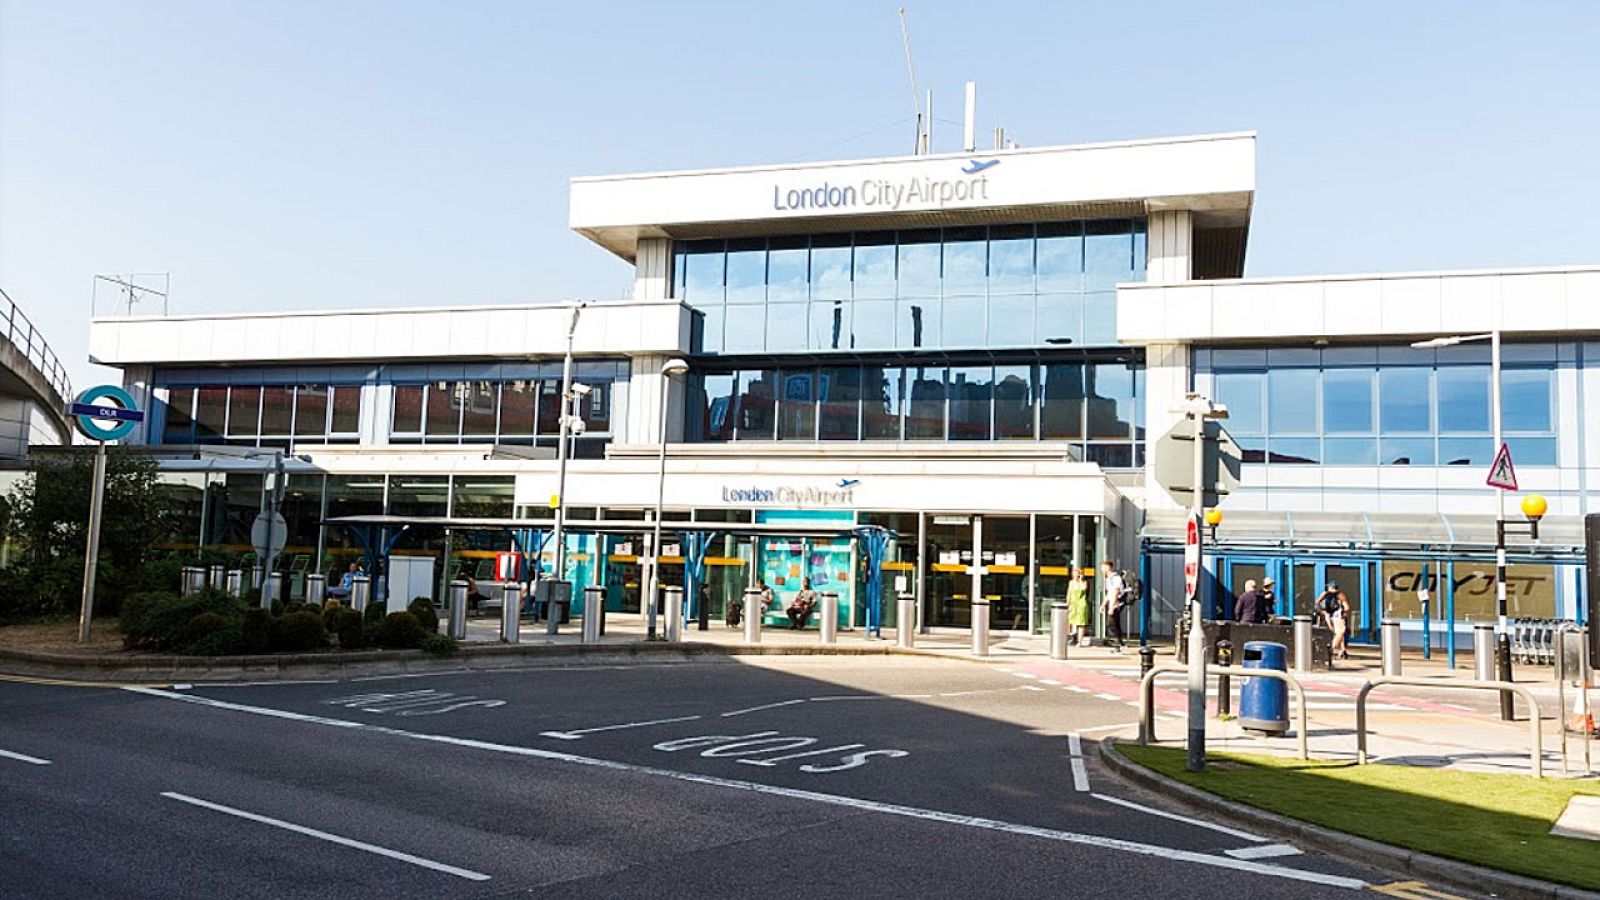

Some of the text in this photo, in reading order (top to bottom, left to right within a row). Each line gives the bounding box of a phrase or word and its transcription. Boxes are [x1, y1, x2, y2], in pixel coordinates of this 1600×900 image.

[774, 174, 989, 210] London City Airport
[99, 408, 117, 417] DLR
[722, 485, 773, 502] London
[653, 730, 909, 773] STOP
